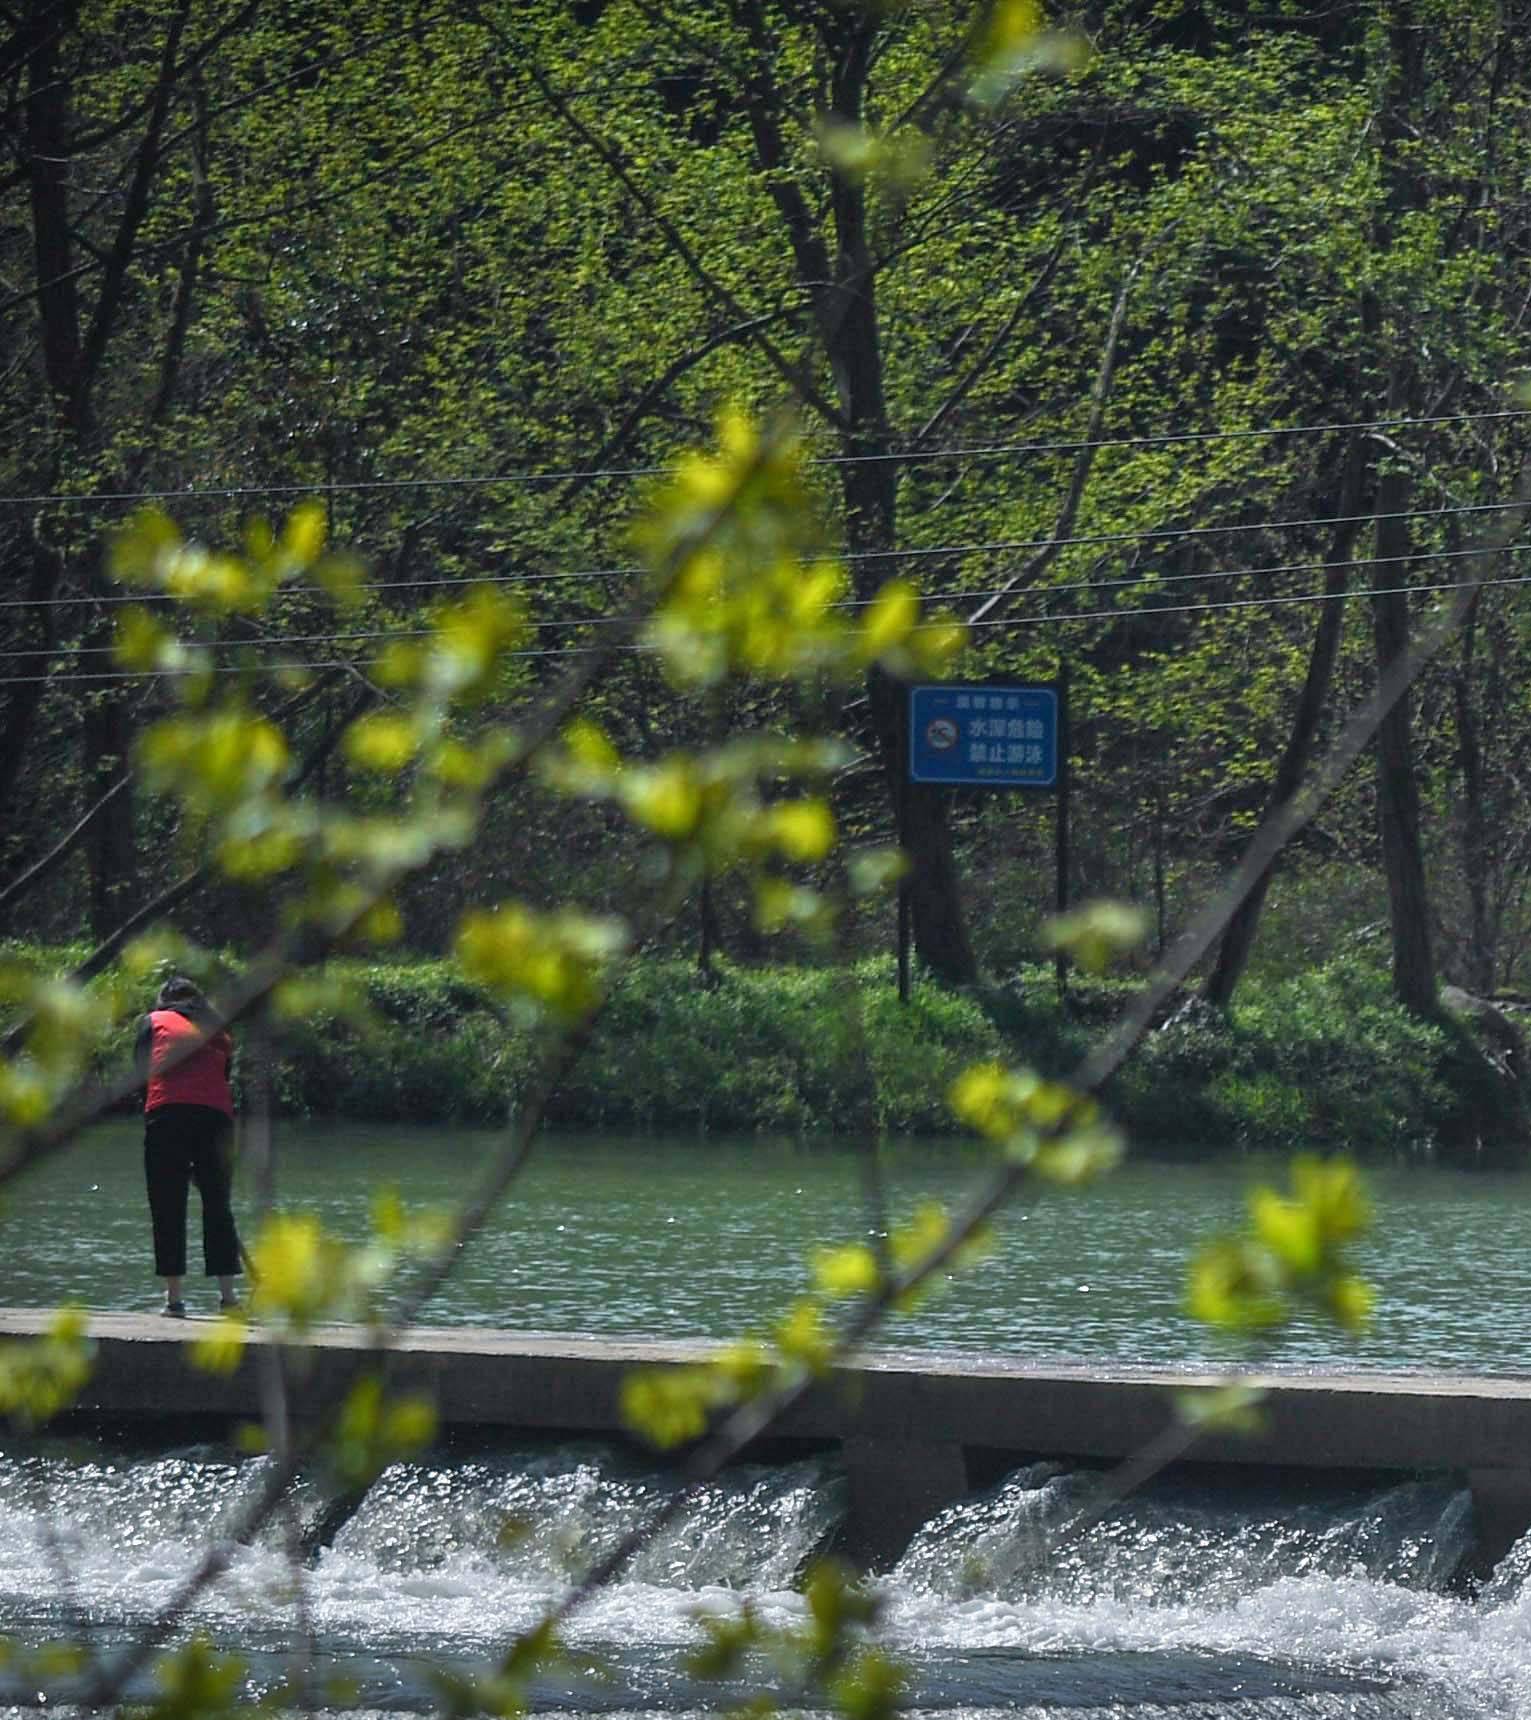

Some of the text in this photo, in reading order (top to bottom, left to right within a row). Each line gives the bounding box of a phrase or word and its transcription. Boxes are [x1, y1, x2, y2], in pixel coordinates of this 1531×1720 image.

[968, 718, 1044, 739] 水深危险
[968, 743, 1043, 764] 禁止游泳
